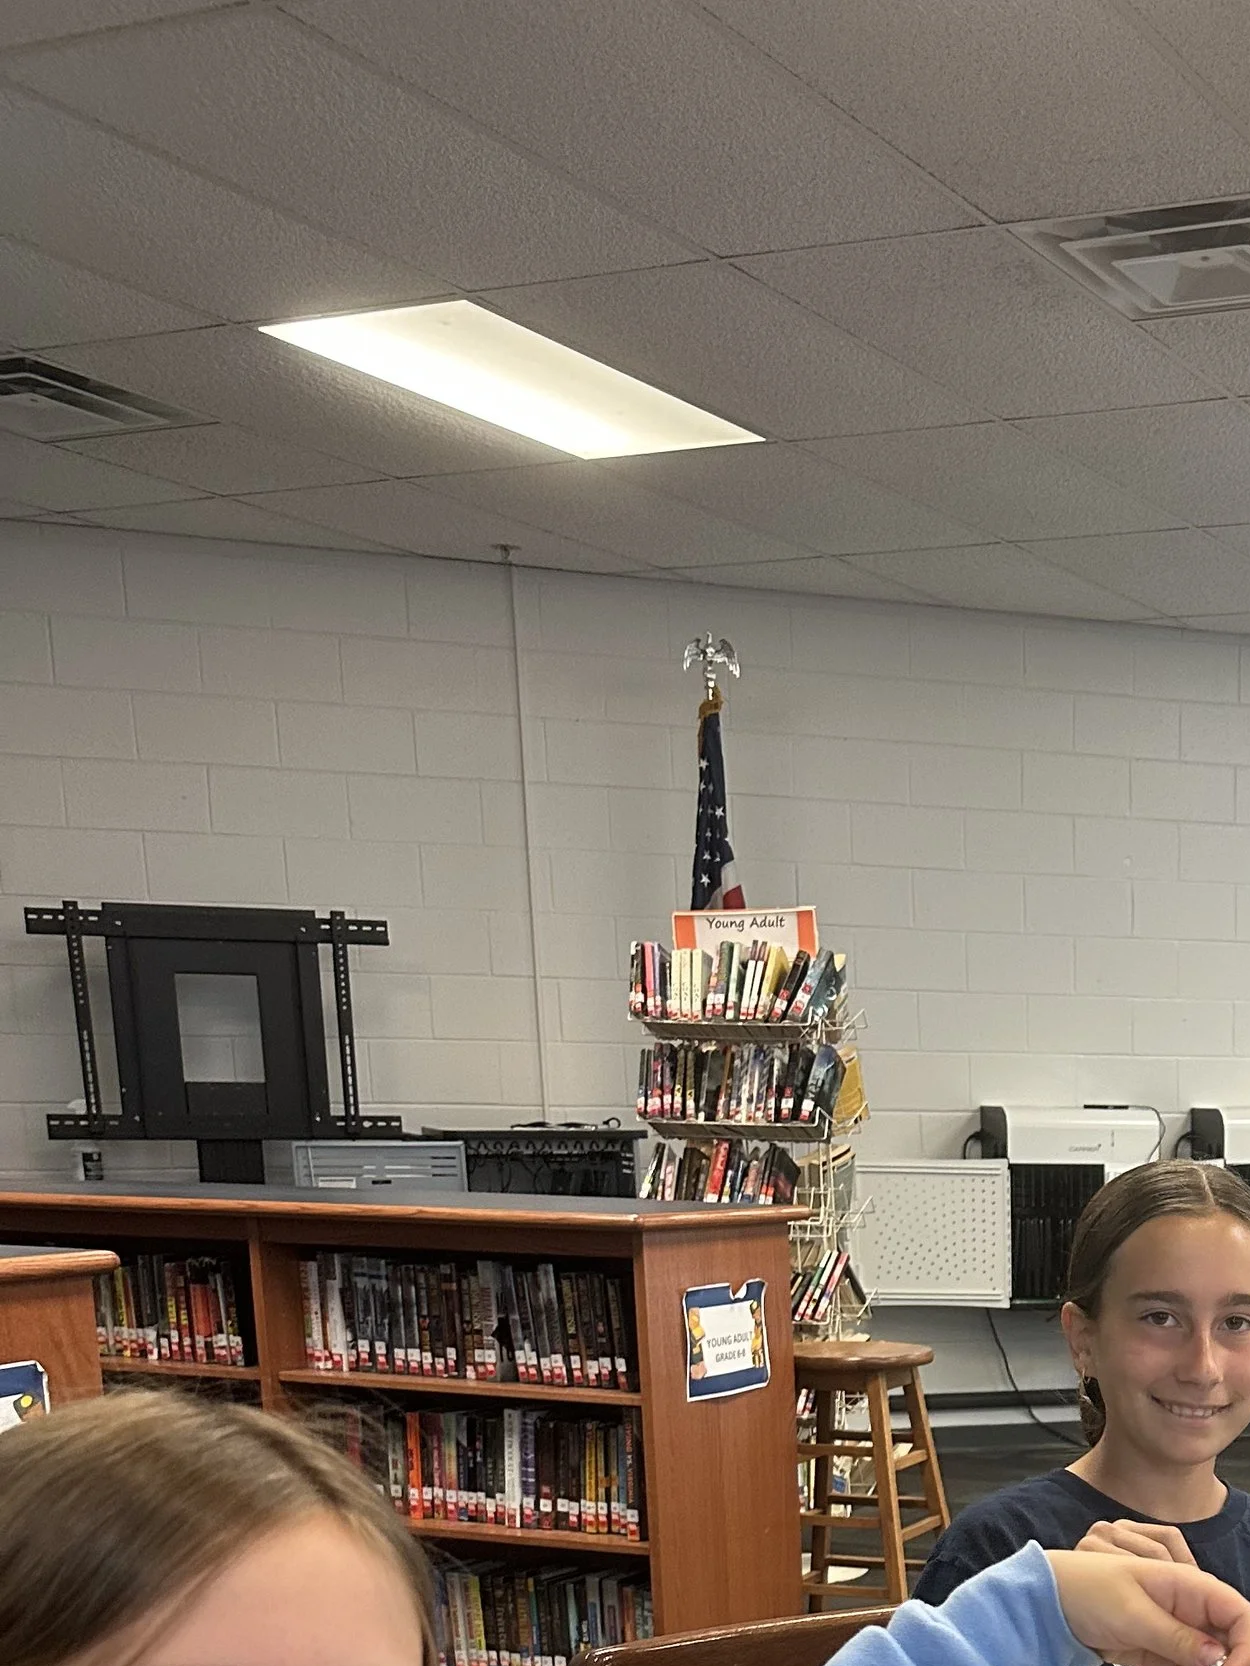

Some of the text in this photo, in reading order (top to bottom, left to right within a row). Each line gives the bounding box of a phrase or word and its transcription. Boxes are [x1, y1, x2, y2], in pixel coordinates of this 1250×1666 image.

[705, 915, 785, 932] Young Adult
[706, 1330, 753, 1348] YOUNG ADULT
[715, 1350, 736, 1363] GRADE
